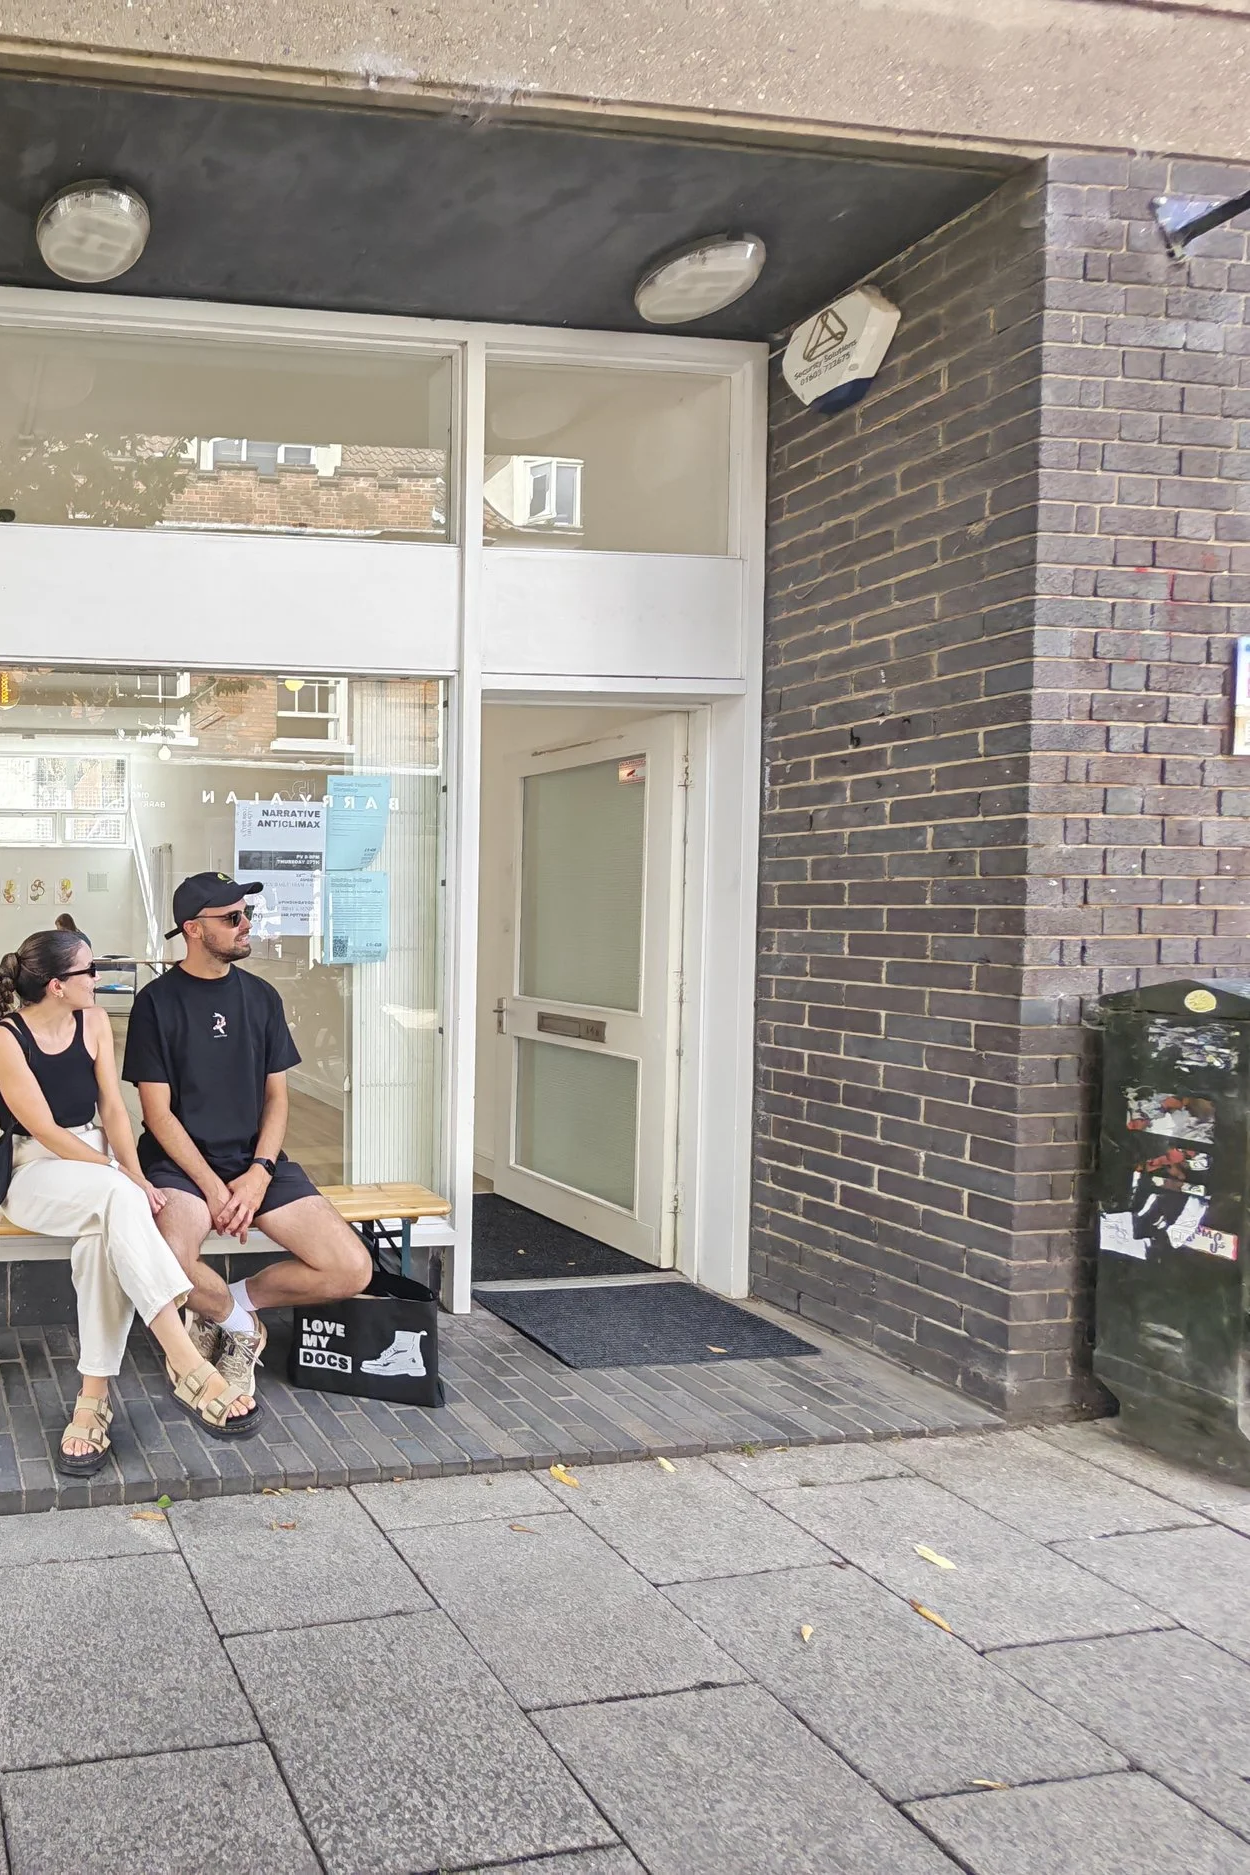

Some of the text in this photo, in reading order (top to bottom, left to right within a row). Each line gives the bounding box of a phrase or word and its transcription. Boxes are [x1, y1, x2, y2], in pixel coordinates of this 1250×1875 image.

[794, 340, 857, 381] Security Solutions
[261, 809, 321, 818] NARRATIVE
[257, 819, 321, 829] ANTICLIMAX
[302, 1318, 346, 1338] LOVE
[302, 1333, 330, 1349] MY
[302, 1351, 349, 1370] DOCS
